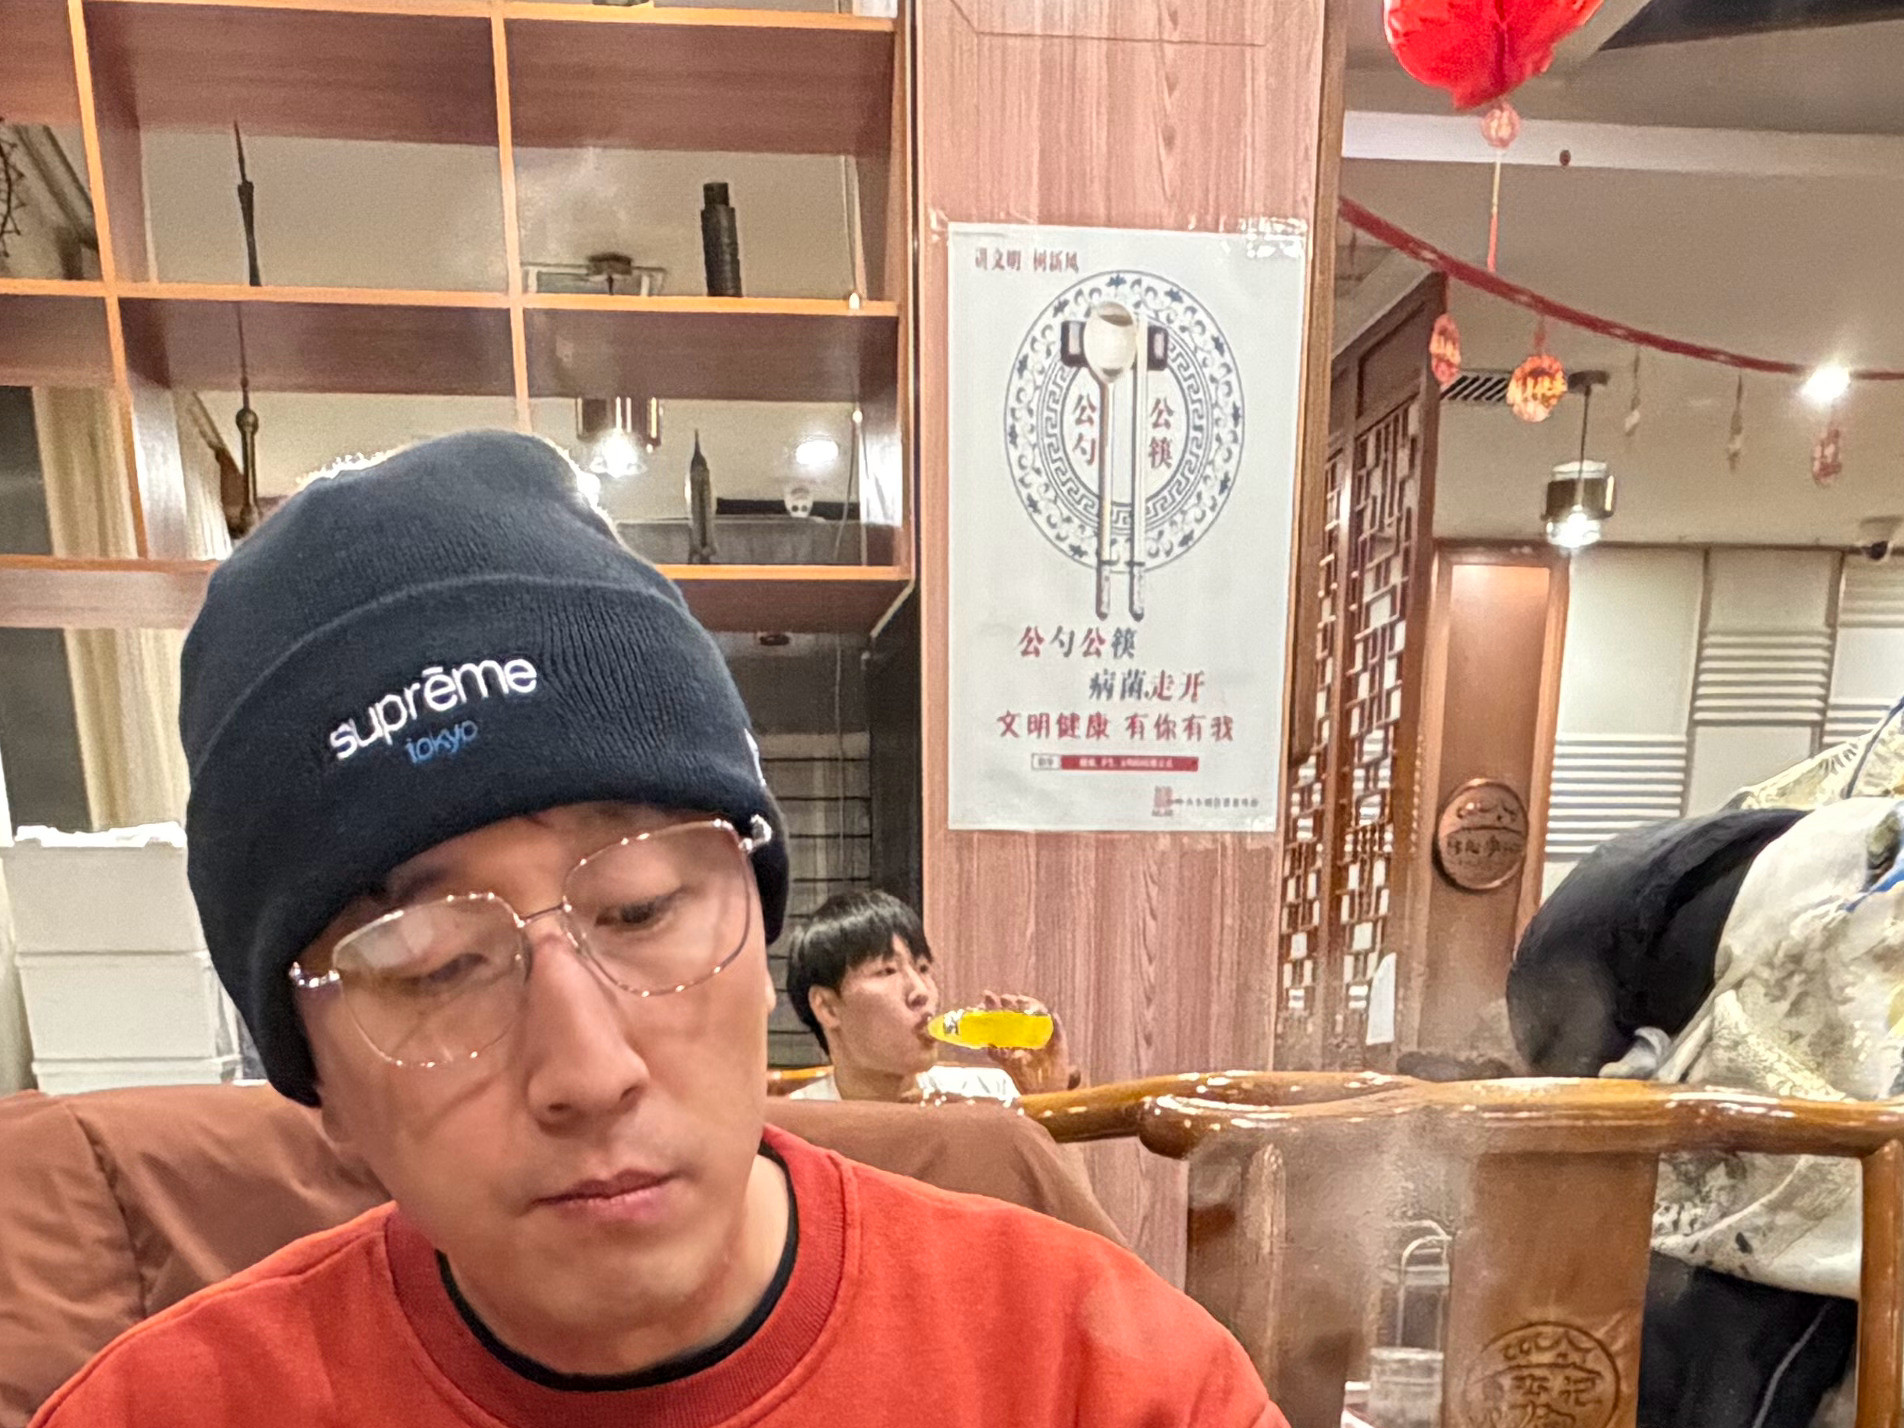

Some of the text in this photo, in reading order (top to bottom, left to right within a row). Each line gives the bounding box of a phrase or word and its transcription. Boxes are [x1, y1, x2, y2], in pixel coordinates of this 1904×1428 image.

[1072, 393, 1096, 466] 公勺
[1148, 397, 1174, 469] 公筷
[1018, 625, 1138, 659] 公勺公筷
[1089, 668, 1206, 703] 病菌走开
[997, 710, 1234, 742] 文明健康 有你有我
